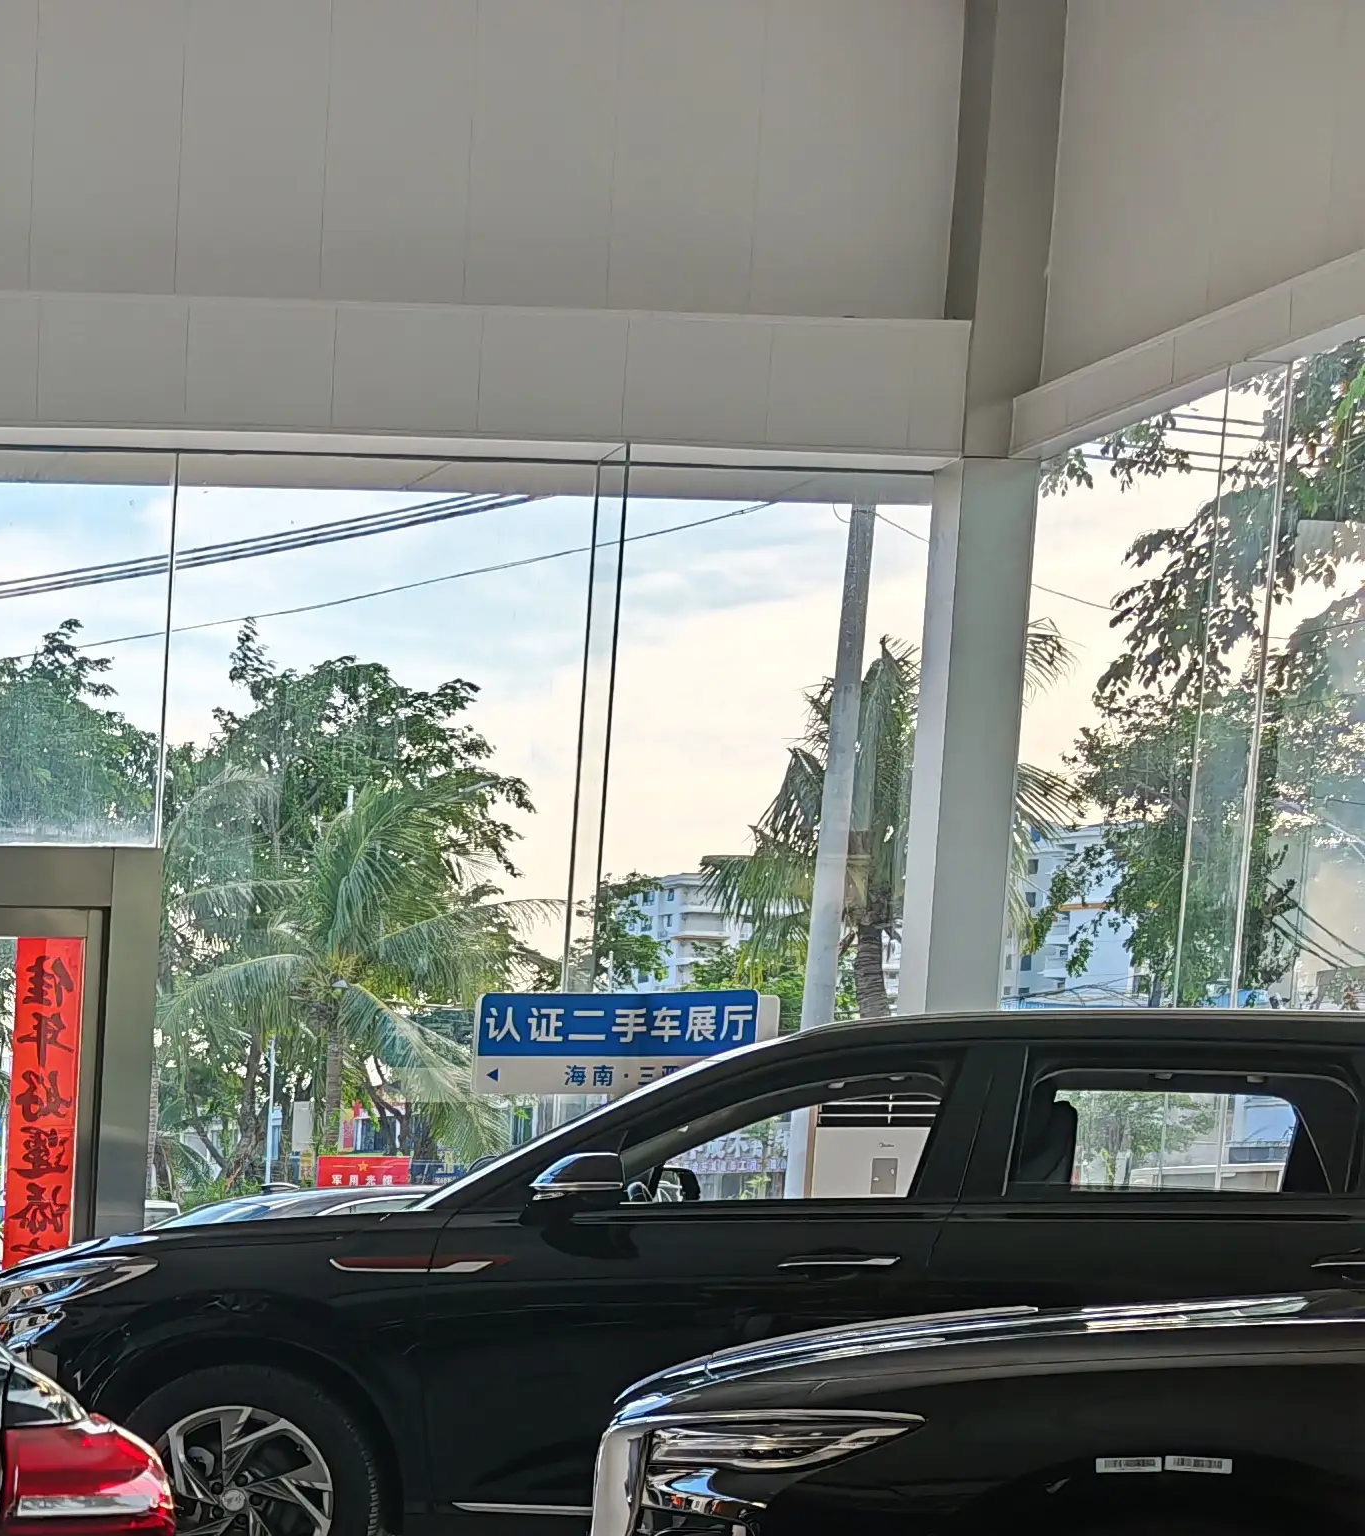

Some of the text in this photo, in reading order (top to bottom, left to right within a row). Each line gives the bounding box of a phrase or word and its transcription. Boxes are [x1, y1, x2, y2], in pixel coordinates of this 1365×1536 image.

[485, 1004, 754, 1044] 认证二手车展厅
